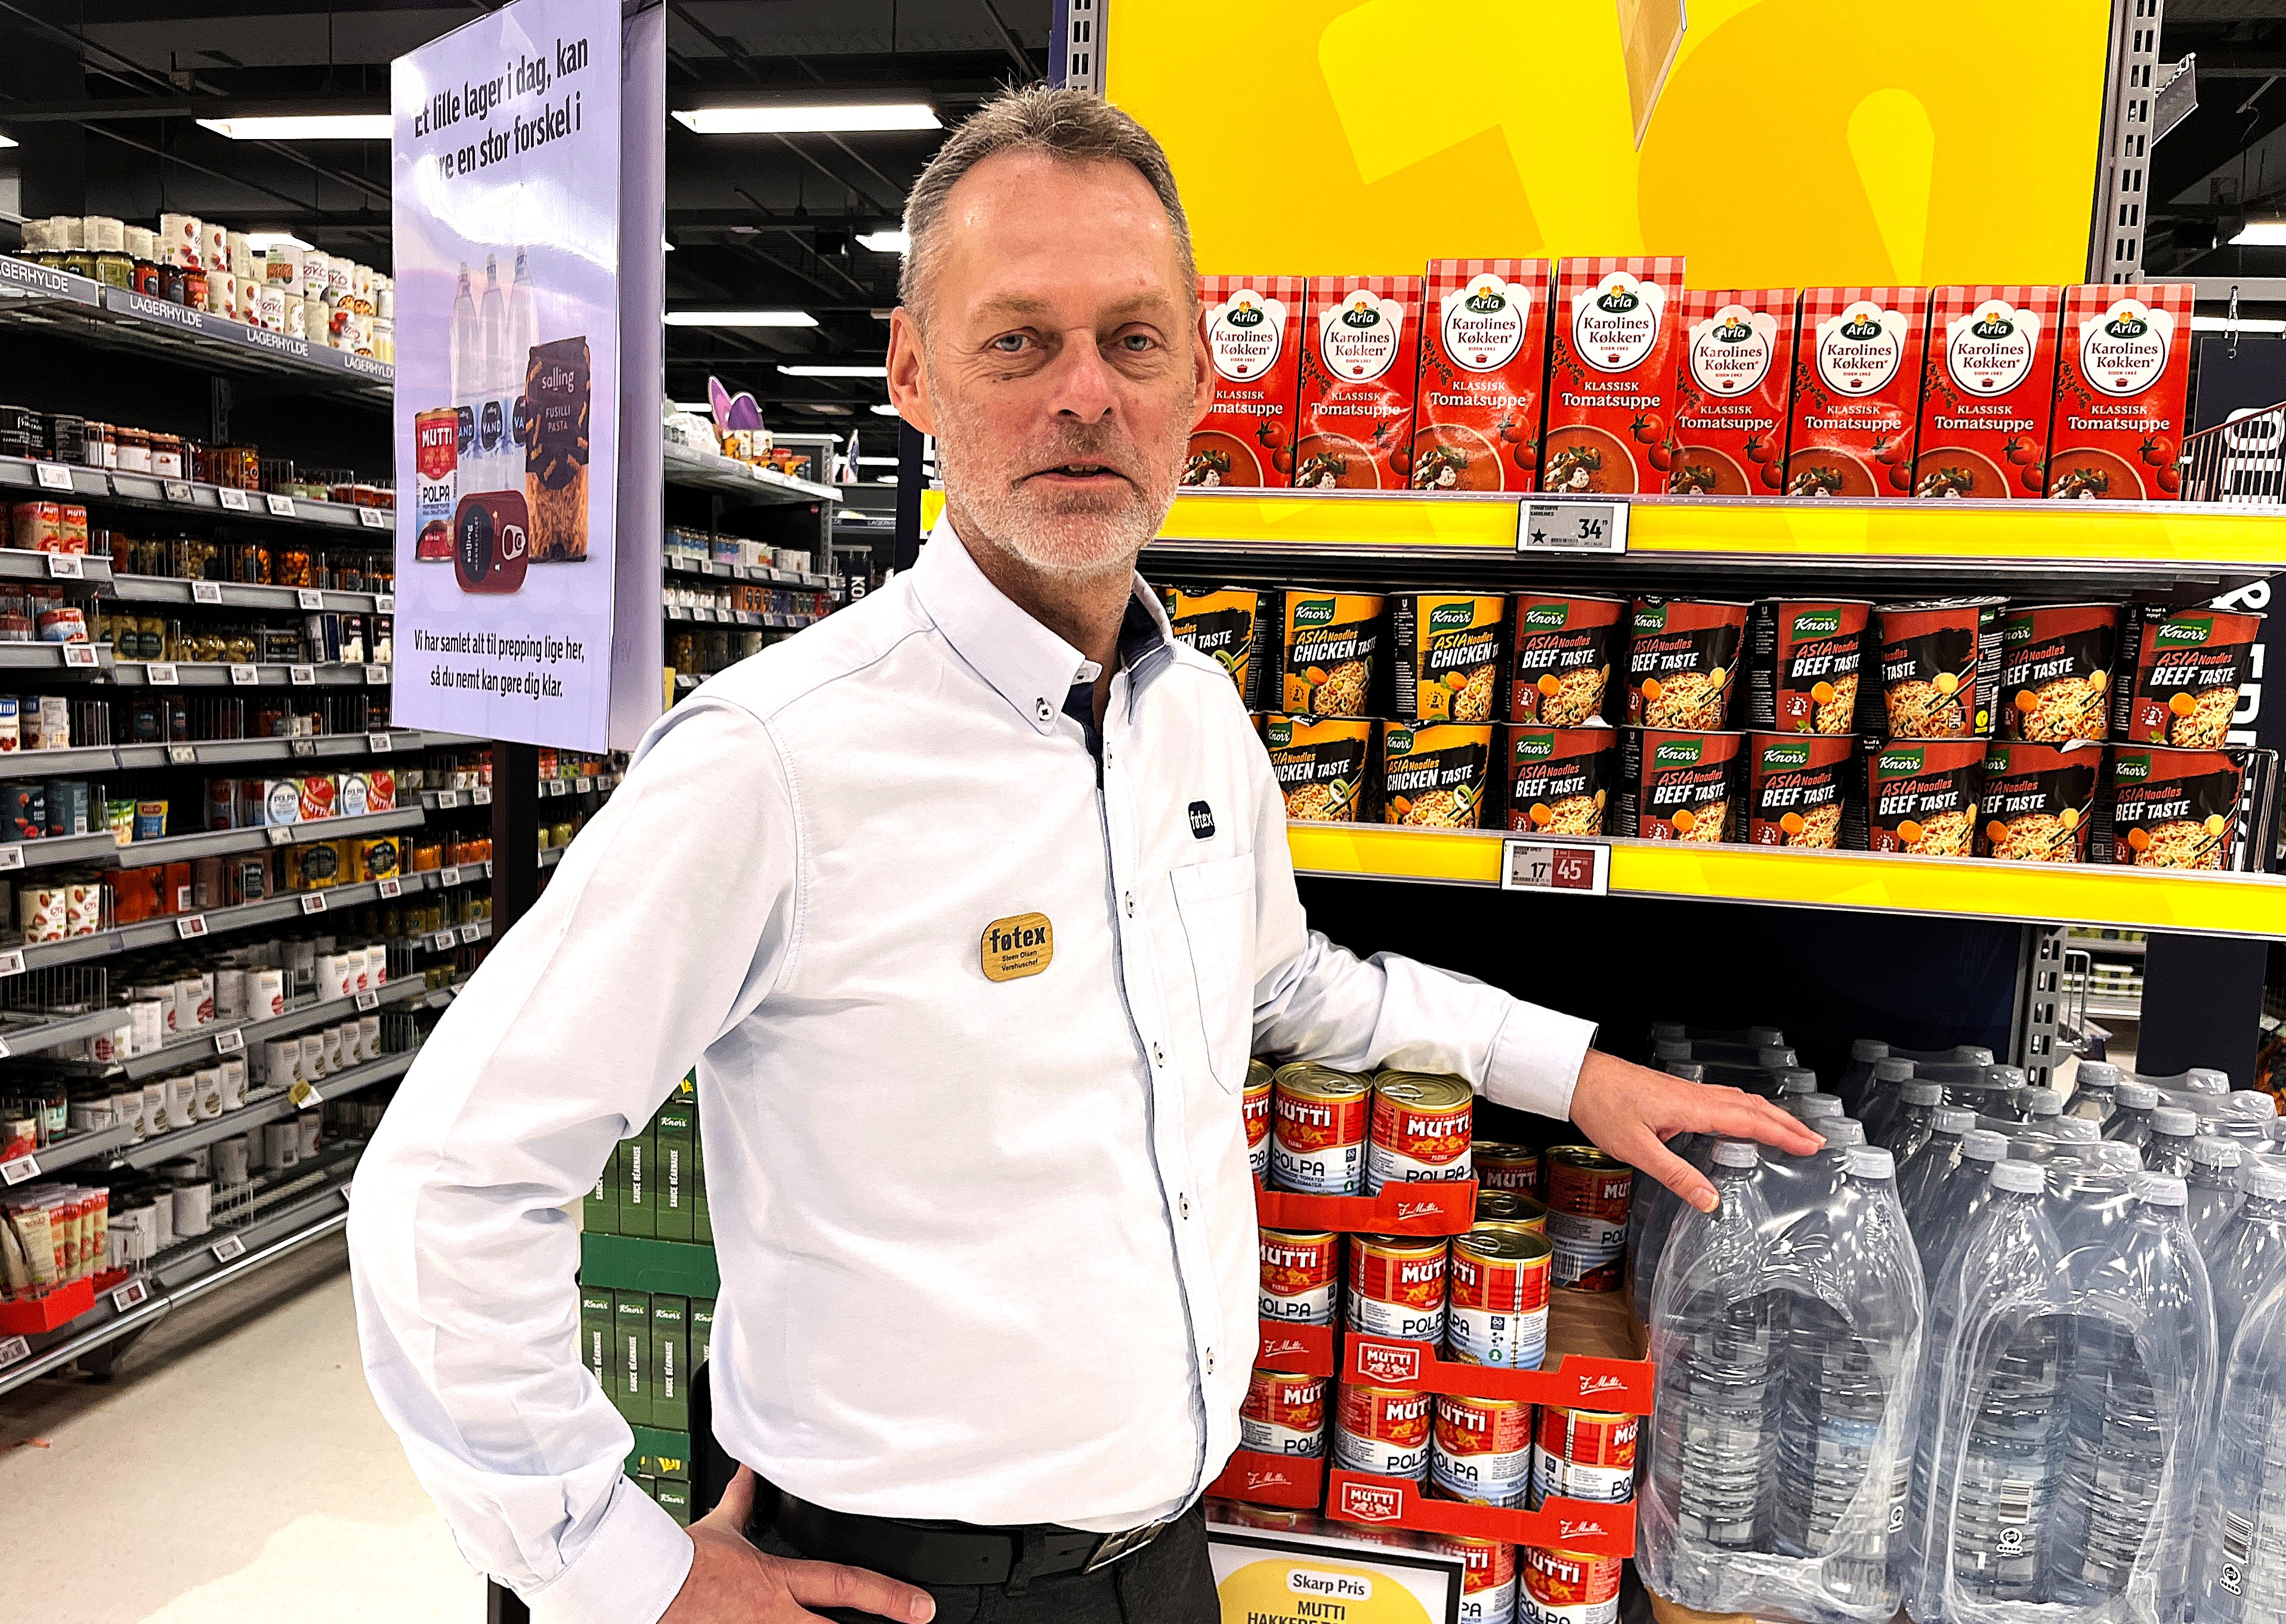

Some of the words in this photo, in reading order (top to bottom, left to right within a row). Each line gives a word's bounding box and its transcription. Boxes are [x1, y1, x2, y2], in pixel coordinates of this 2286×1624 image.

[415, 107, 430, 138] Et
[433, 89, 460, 130] lille
[464, 75, 503, 121] lager
[507, 62, 511, 99] i
[516, 55, 551, 95] dag,
[557, 38, 588, 78] kan
[458, 144, 476, 175] en
[480, 126, 511, 168] stor
[514, 94, 571, 155] forskel
[576, 91, 581, 131] i
[0, 261, 69, 292] GERHYLDE
[1471, 297, 1499, 310] Arla
[1602, 297, 1632, 310] Arla
[131, 295, 202, 328] LAGERHYLDE
[1348, 311, 1374, 323] Arla
[1453, 318, 1515, 331] Karolines
[1584, 317, 1649, 329] Karolines
[1846, 325, 1876, 336] Arla
[1977, 323, 2007, 335] Arla
[2111, 322, 2140, 335] Arla
[246, 329, 309, 357] LAGERHYLDE
[1330, 331, 1389, 344] Karolines
[1457, 331, 1512, 344] Køkken
[1589, 331, 1645, 343] Køkken
[1336, 344, 1386, 356] Køkken
[1827, 344, 1892, 356] Karolines
[1958, 343, 2024, 355] Karolines
[2092, 342, 2158, 355] Karolines
[345, 356, 394, 379] LAGERHYLD
[1833, 358, 1888, 369] Køkken
[1963, 357, 2020, 369] Køkken
[2097, 356, 2154, 369] Køkken
[542, 367, 574, 393] salling
[1453, 381, 1506, 391] KLASSISK
[1584, 381, 1639, 391] KLASSISK
[1332, 392, 1381, 402] KLASSISK
[1431, 393, 1526, 409] Tomatsuppe
[1561, 393, 1660, 410] Tomatsuppe
[545, 405, 570, 418] FUSILLI
[1311, 402, 1401, 418] Tomatsuppe
[1827, 405, 1880, 415] KLASSISK
[1957, 405, 2012, 415] KLASSISK
[2091, 405, 2148, 415] KLASSISK
[482, 420, 501, 434] VAND
[514, 416, 525, 430] VA
[548, 420, 568, 433] PASTA
[1805, 416, 1901, 431] Tomatsuppe
[1934, 416, 2034, 433] Tomatsuppe
[2068, 416, 2170, 433] Tomatsuppe
[422, 427, 453, 447] MUTTI
[458, 424, 473, 438] AND
[423, 485, 450, 503] POLPA
[1578, 519, 1602, 539] 34
[1296, 607, 1332, 620] Knorr
[1432, 610, 1472, 623] Knorr
[1526, 610, 1564, 625] Knorr
[1794, 618, 1837, 632] Knorr
[2159, 624, 2207, 641] Knorr
[1297, 630, 1328, 644] ASIA
[1328, 629, 1358, 642] Noodles
[1435, 635, 1467, 650] ASIA
[1467, 632, 1493, 646] Noodles
[1527, 637, 1560, 651] ASIA
[1559, 635, 1590, 648] Noodles
[415, 629, 422, 651] Vi
[424, 630, 440, 651] har
[441, 632, 471, 653] samlet
[472, 632, 485, 654] alt
[487, 633, 496, 655] til
[499, 634, 542, 663] prepping
[544, 635, 563, 663] lige
[566, 635, 584, 663] her,
[1294, 639, 1355, 662] CHICKEN
[1796, 641, 1833, 658] ASIA
[1832, 640, 1858, 654] Noodles
[1431, 643, 1492, 668] CHICKEN
[1522, 649, 1559, 669] BEEF
[1560, 649, 1596, 666] TASTE
[2157, 652, 2199, 667] ASIA
[2198, 653, 2233, 665] Noodles
[1792, 655, 1833, 678] BEEF
[1833, 654, 1861, 673] TASTE
[431, 665, 440, 686] så
[442, 665, 454, 687] du
[456, 668, 480, 690] nemt
[481, 668, 498, 691] kan
[501, 675, 522, 697] gøre
[524, 671, 539, 700] dig
[542, 673, 563, 697] klar.
[2149, 666, 2199, 686] BEEF
[2198, 666, 2236, 685] TASTE
[1387, 736, 1411, 749] Knorr
[1516, 742, 1550, 755] Knorr
[1657, 747, 1698, 760] Knorr
[1764, 750, 1805, 764] Knorr
[1388, 759, 1410, 773] ASIA
[1409, 759, 1439, 771] Noodles
[1518, 764, 1547, 779] ASIA
[1547, 764, 1580, 776] Noodles
[2116, 762, 2146, 776] Knorr
[1387, 769, 1438, 791] CHICKEN
[1441, 765, 1473, 785] TASTE
[1658, 771, 1694, 786] ASIA
[1694, 770, 1722, 783] Noodles
[1766, 774, 1801, 789] ASIA
[1801, 773, 1831, 786] Noodles
[1516, 779, 1548, 798] BEEF
[1550, 776, 1586, 795] TASTE
[1654, 785, 1694, 804] BEEF
[1694, 783, 1726, 801] TASTE
[2118, 788, 2144, 802] ASIA
[2144, 787, 2182, 799] Noodles
[1762, 787, 1803, 807] BEEF
[1803, 785, 1836, 803] TASTE
[2115, 802, 2145, 821] BEEF
[2147, 801, 2190, 819] TASTE
[1531, 863, 1546, 878] 17
[1558, 859, 1581, 880] 45
[989, 926, 1046, 953] føtex
[1002, 953, 1019, 962] Steen
[1002, 959, 1038, 971] Varehuschef
[1275, 1097, 1331, 1127] MUTTI
[661, 1117, 687, 1127] Knorr
[1407, 1115, 1469, 1137] MUTTI
[1274, 1148, 1324, 1176] POLPA
[583, 1299, 608, 1310] Knorr
[619, 1305, 644, 1315] Knorr
[656, 1310, 681, 1320] Knorr
[1367, 1348, 1411, 1364] MUTTI
[1351, 1490, 1394, 1505] MUTTI
[1293, 1574, 1333, 1594] Skarp
[1338, 1579, 1365, 1595] Pris
[1298, 1601, 1346, 1620] MUTTI
